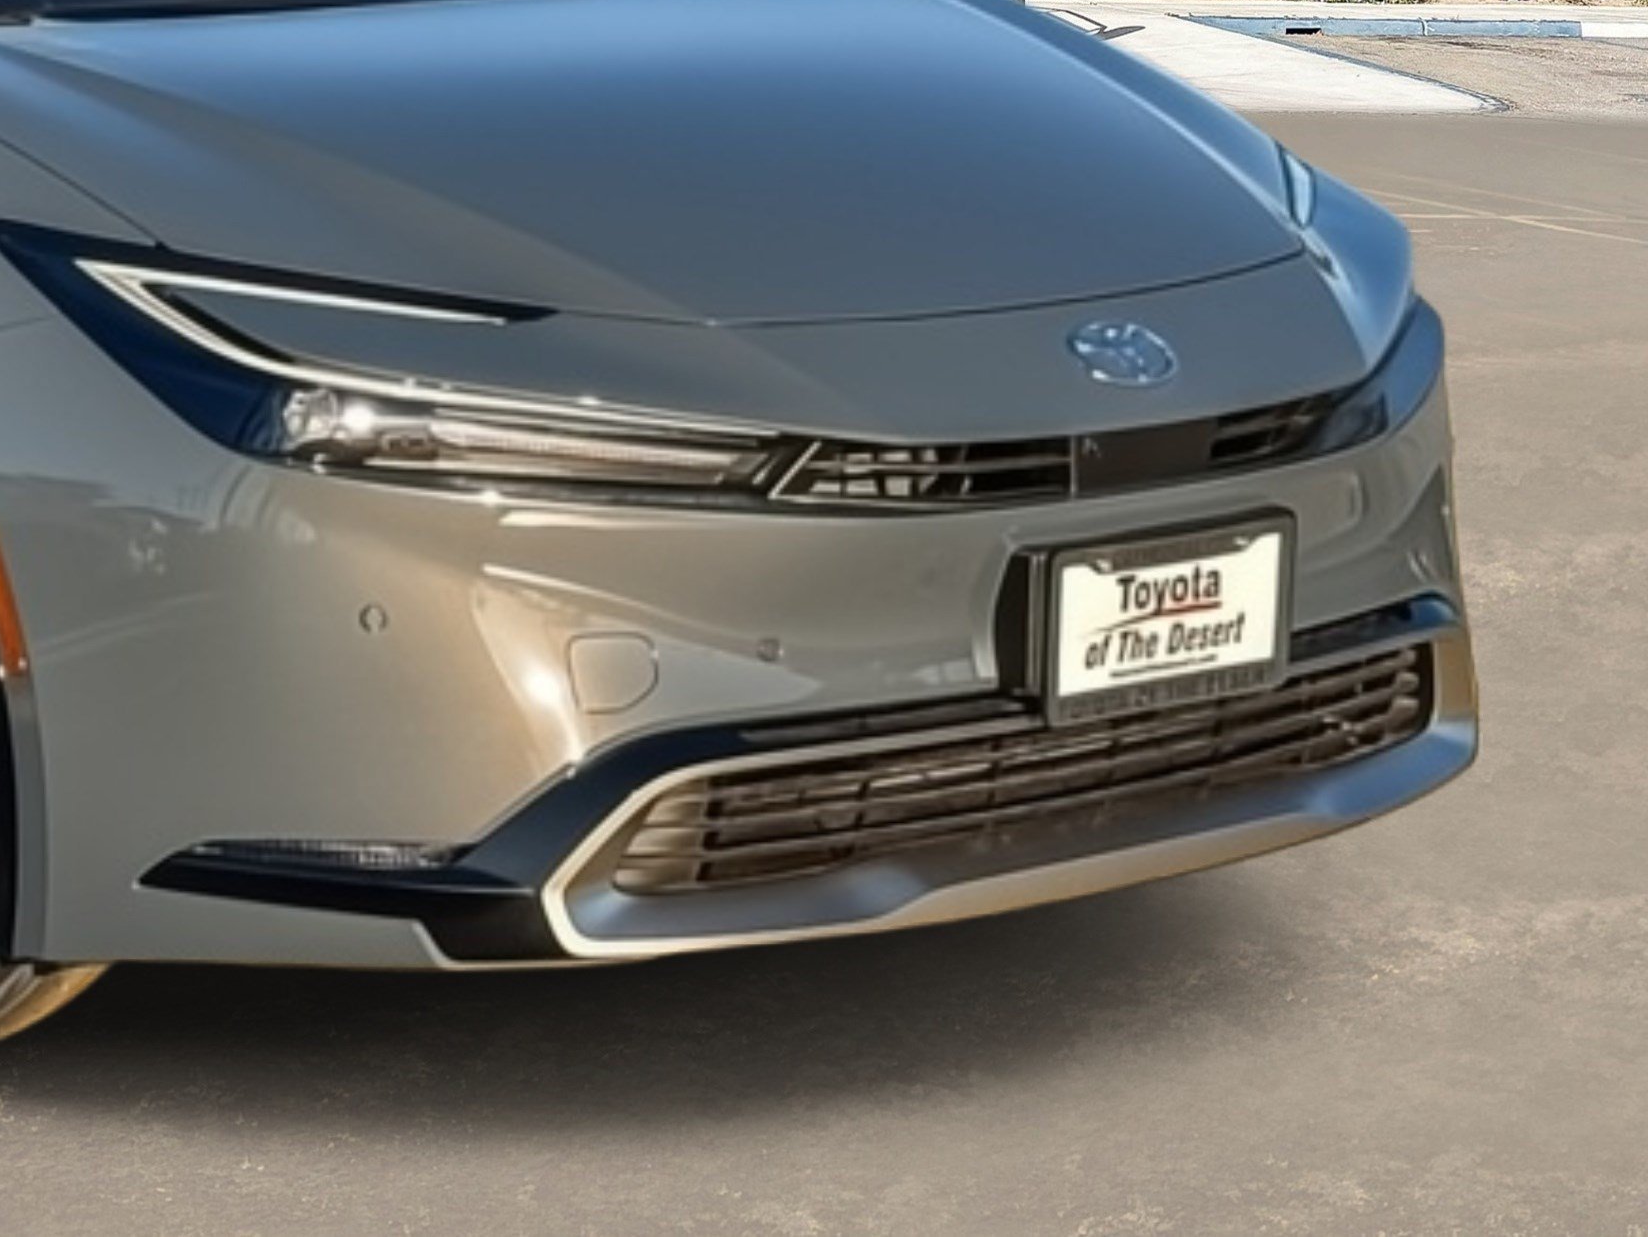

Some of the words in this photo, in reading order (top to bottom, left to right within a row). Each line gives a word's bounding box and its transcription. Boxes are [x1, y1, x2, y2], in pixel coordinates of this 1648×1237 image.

[1116, 564, 1221, 616] Toyota
[1084, 632, 1112, 670] of
[1117, 628, 1160, 664] The
[1166, 611, 1245, 655] Desert
